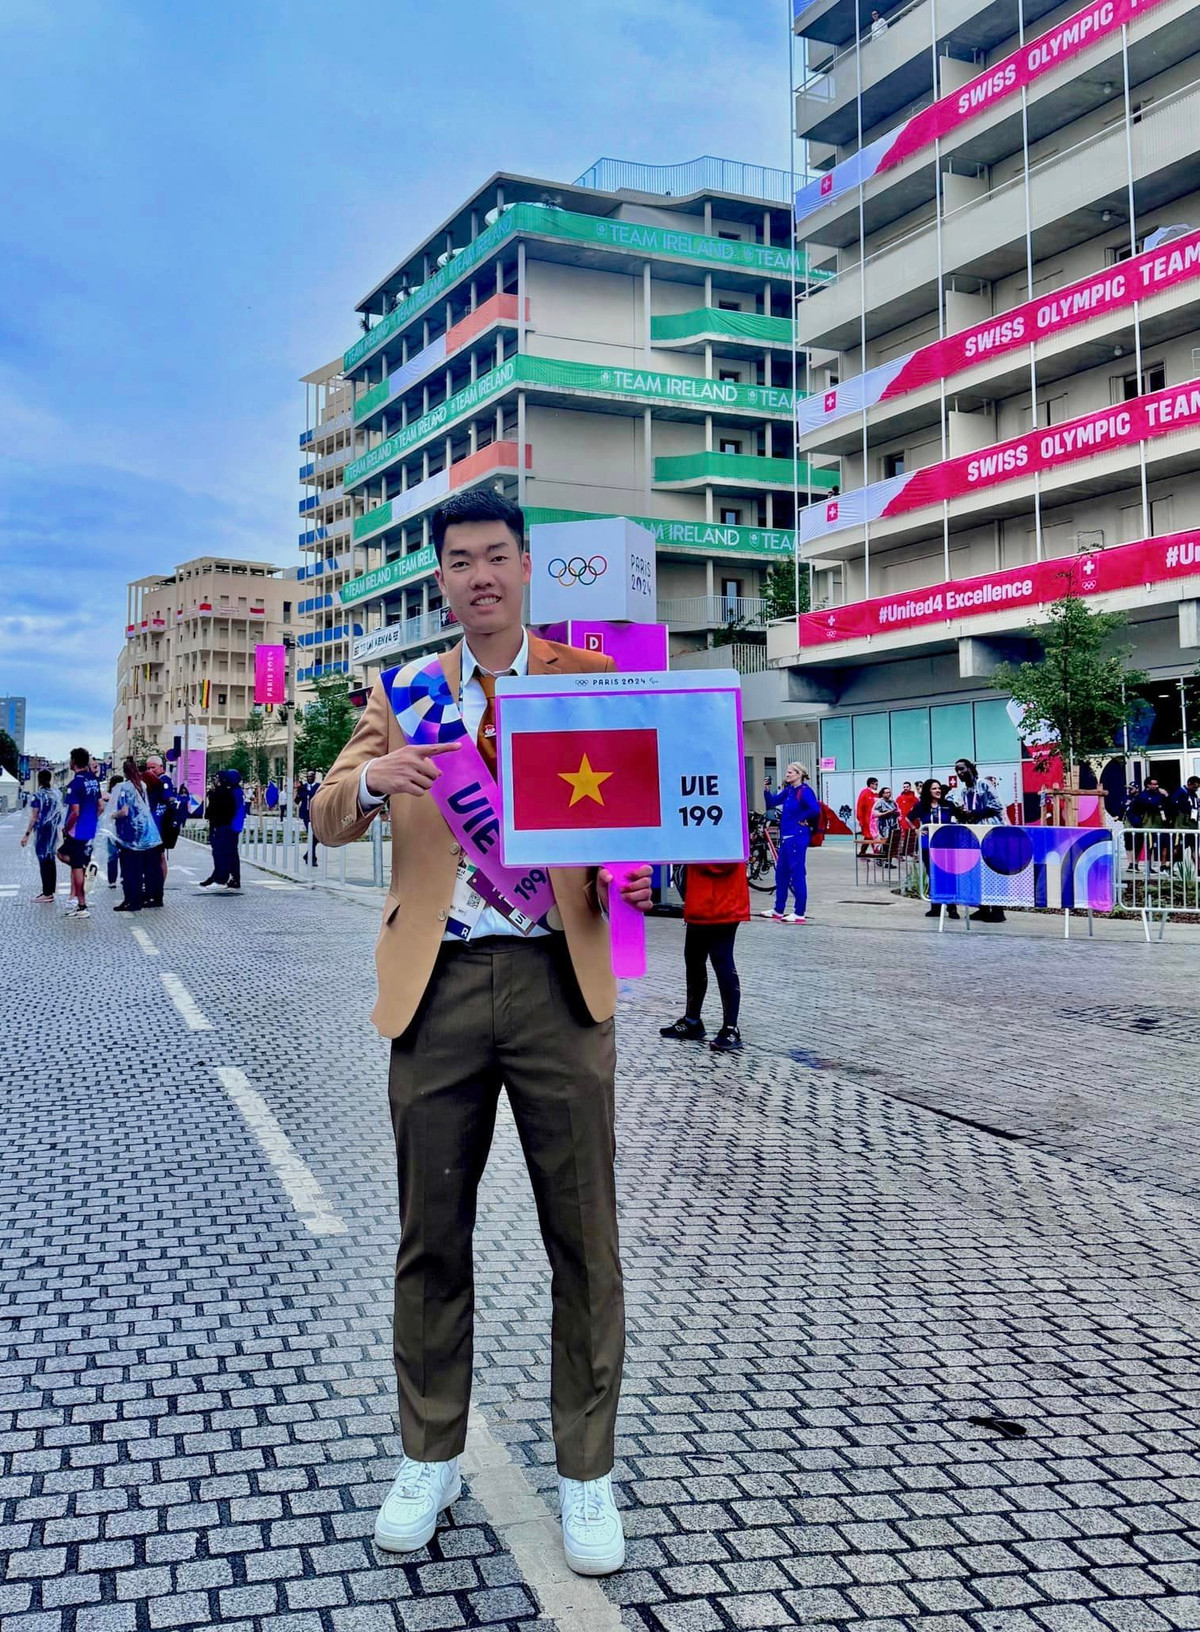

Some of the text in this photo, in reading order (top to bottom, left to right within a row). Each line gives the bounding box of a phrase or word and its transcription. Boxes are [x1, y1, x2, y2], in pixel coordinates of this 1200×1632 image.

[958, 2, 1114, 114] SWISS OLYMPIC
[609, 224, 659, 249] TEAM
[662, 232, 734, 260] IRELAND
[755, 249, 800, 271] TEAM
[965, 316, 1024, 357] SWISS
[1037, 275, 1125, 329] OLYMPIC
[613, 371, 661, 393] TEAM
[666, 379, 737, 402] IRELAND
[350, 363, 514, 477] TEAM IRELAND TEAM IRELAND TEAM IRELAND
[967, 445, 1028, 482] SWISS
[1041, 412, 1131, 459] OLYMPIC
[668, 524, 740, 546] IRELAND
[761, 532, 797, 550] TEA
[349, 546, 437, 597] TEAM IRELAND TEAM IRELA
[631, 554, 651, 577] PARIS
[631, 574, 651, 597] 2024
[879, 578, 1032, 624] #United4 Excellence
[589, 636, 599, 650] D
[592, 677, 646, 686] PARIS 2024
[678, 805, 723, 827] 199
[513, 869, 547, 901] 199
[461, 927, 469, 938] R
